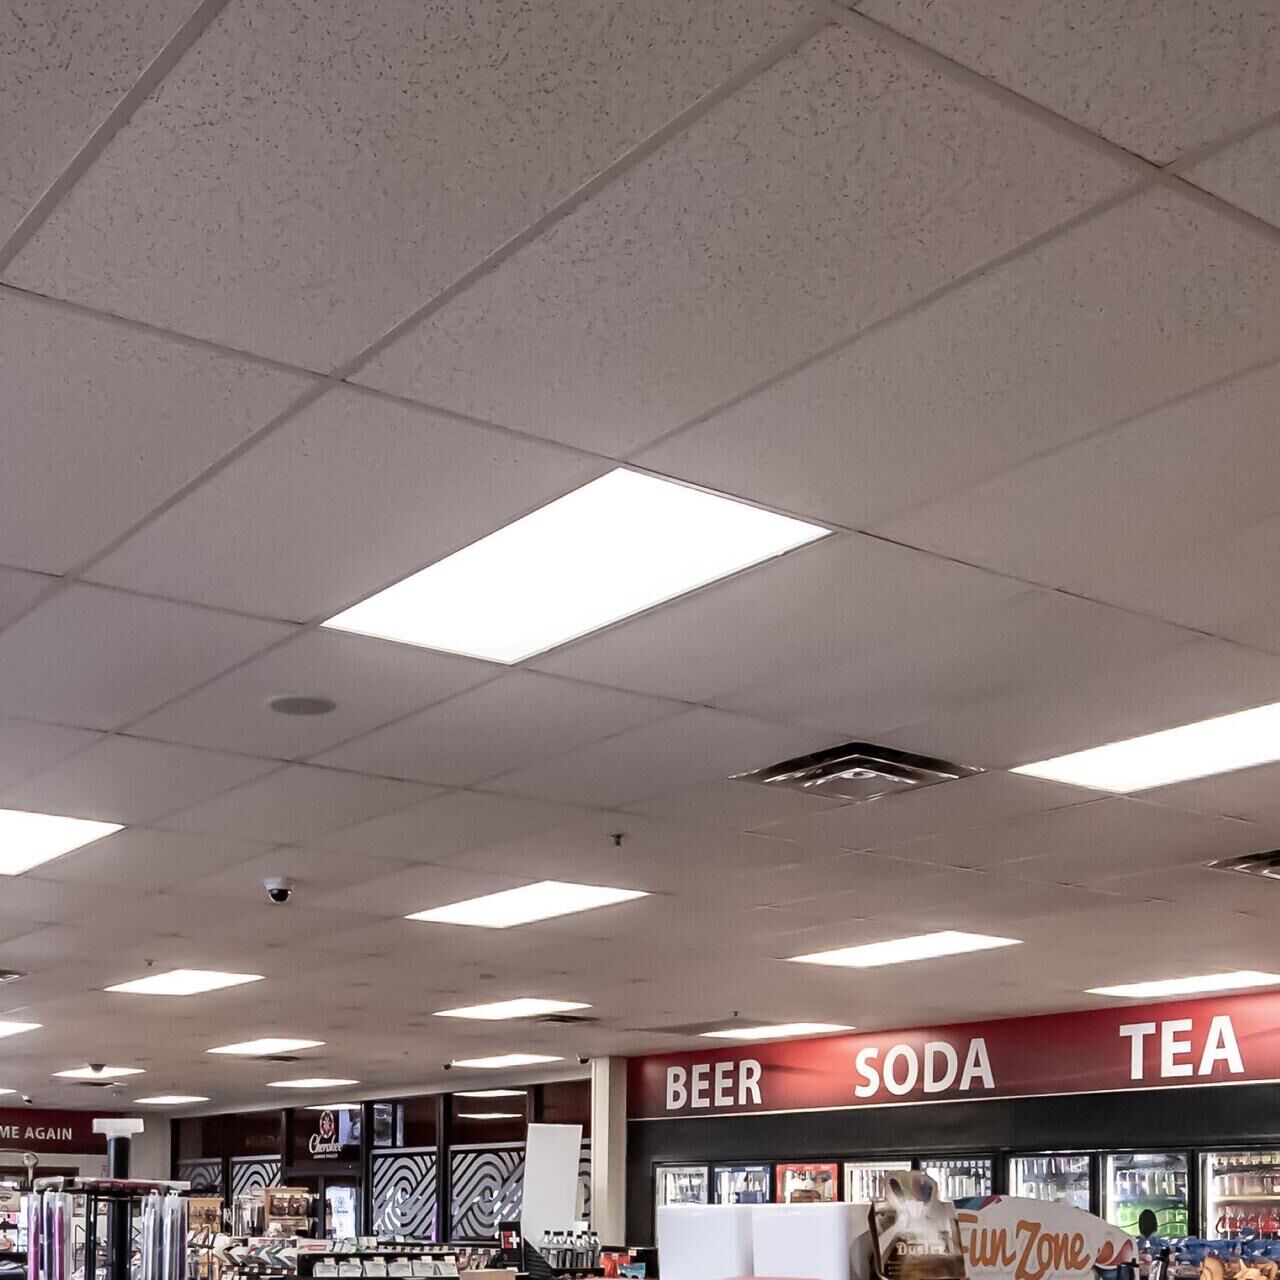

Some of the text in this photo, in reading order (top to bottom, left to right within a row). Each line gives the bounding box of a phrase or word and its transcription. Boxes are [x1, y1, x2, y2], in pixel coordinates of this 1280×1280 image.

[854, 1037, 995, 1098] SODA
[1120, 1015, 1244, 1081] TEA
[665, 1058, 763, 1110] BEER
[24, 1126, 72, 1141] AGAIN
